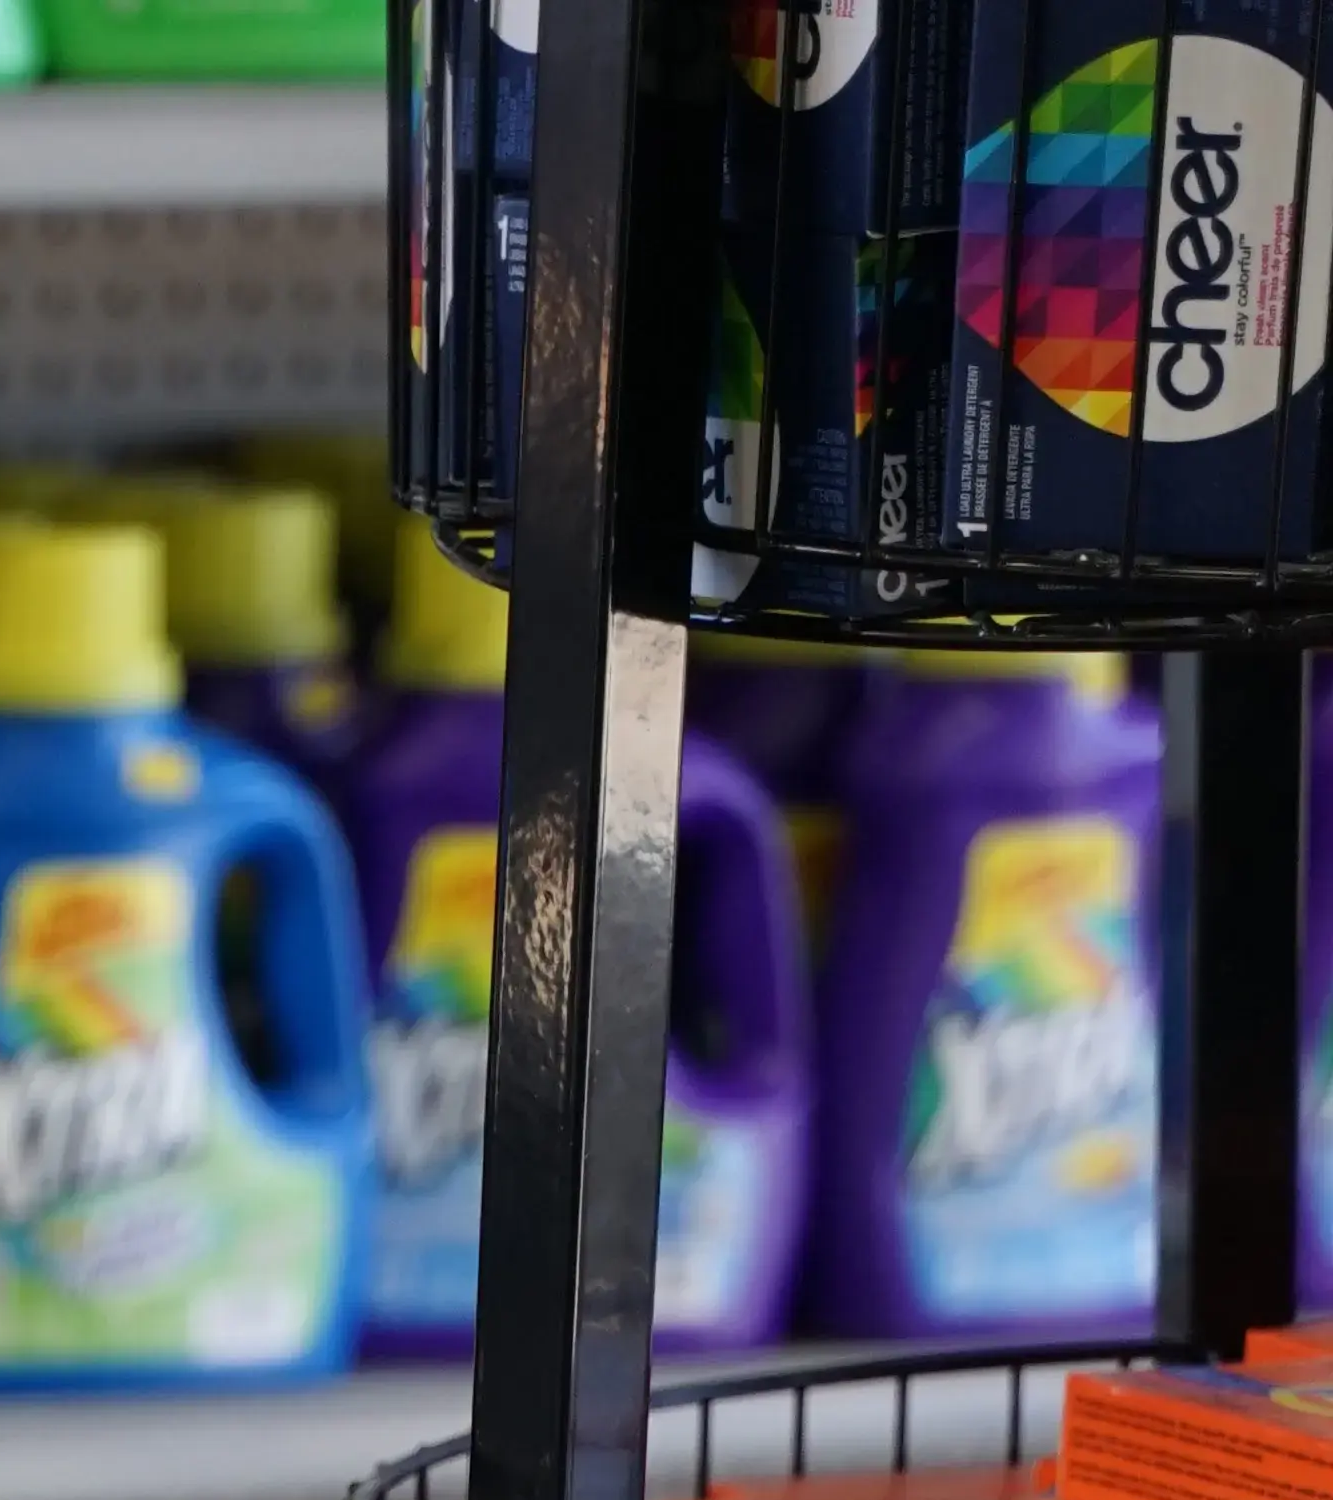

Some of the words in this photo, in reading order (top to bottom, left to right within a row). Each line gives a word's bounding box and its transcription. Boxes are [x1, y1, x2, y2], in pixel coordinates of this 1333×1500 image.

[1233, 313, 1249, 347] stay
[965, 364, 980, 417] DETERGENT
[962, 419, 977, 462] LAUNDRY
[976, 463, 988, 475] DE
[1023, 452, 1035, 464] LA
[960, 463, 973, 492] ULTRA
[1021, 466, 1034, 490] PARA
[959, 493, 971, 518] LOAD
[956, 521, 988, 538] 1
